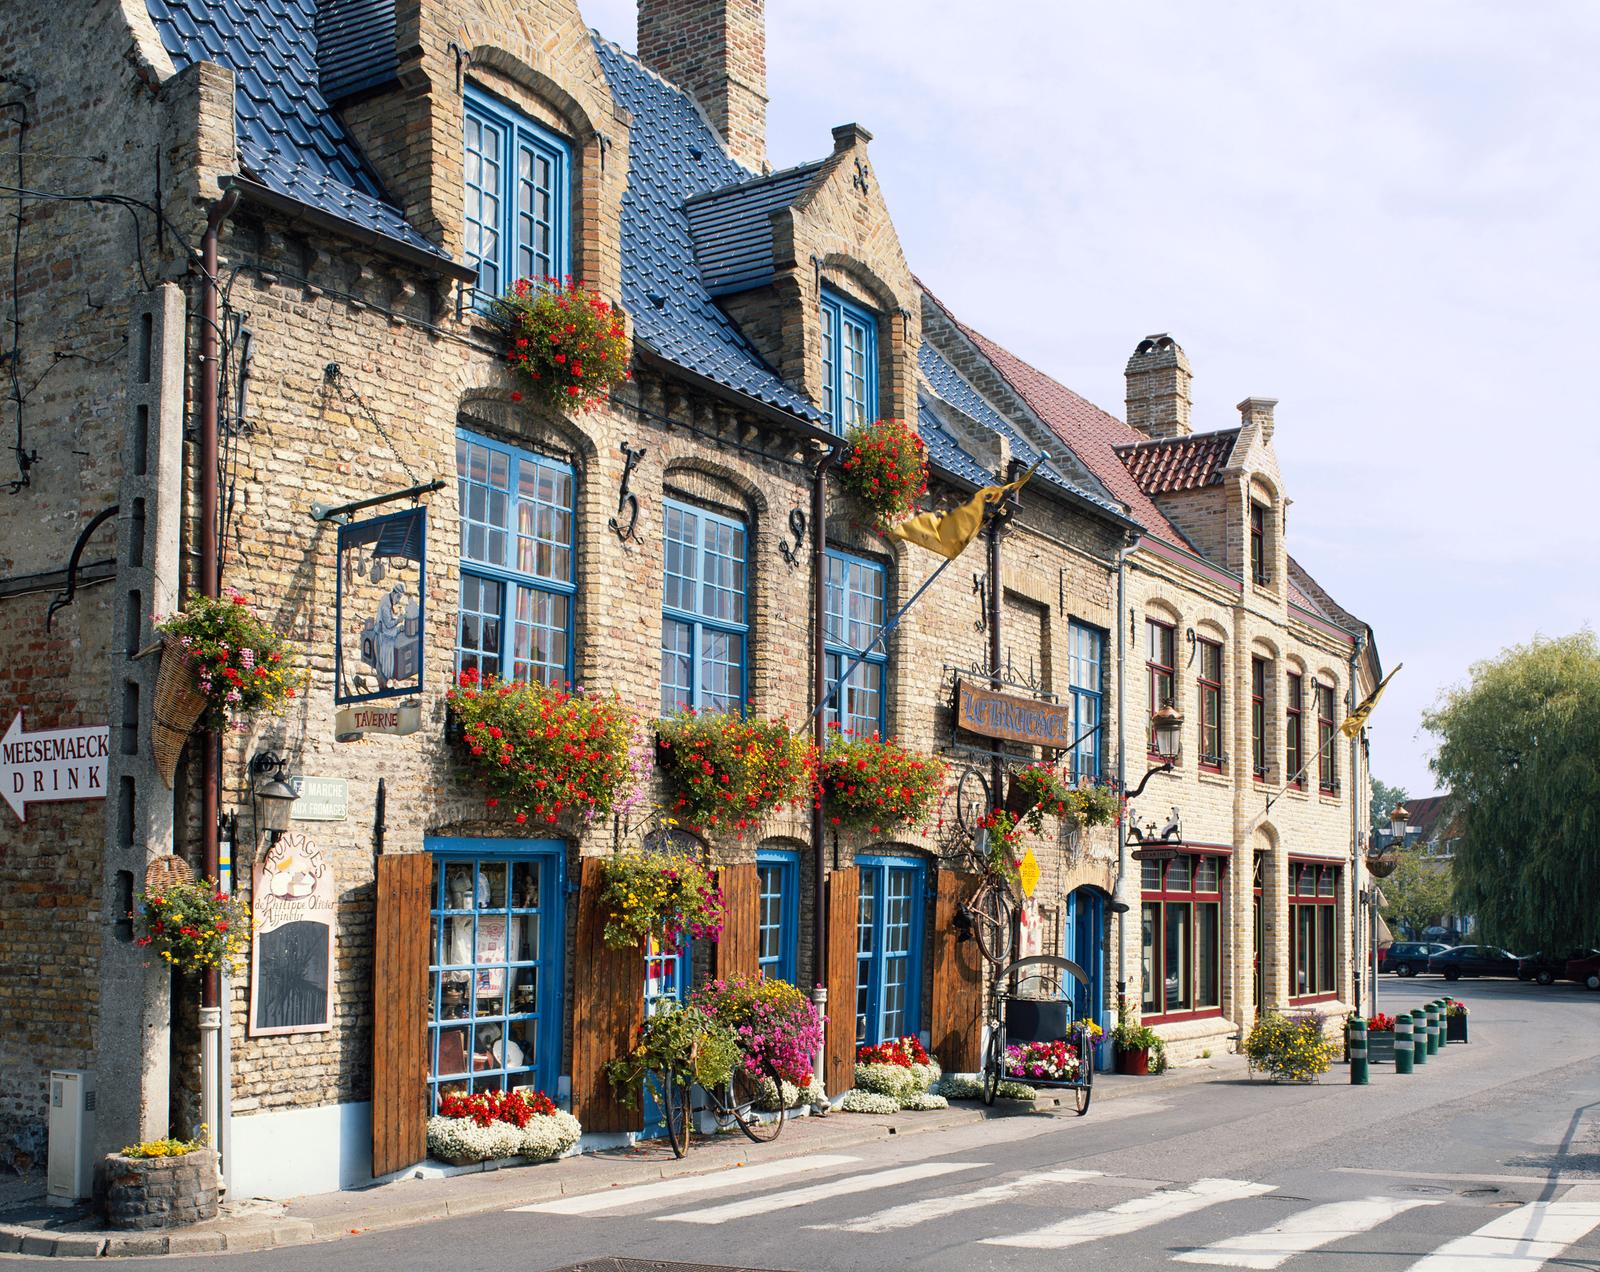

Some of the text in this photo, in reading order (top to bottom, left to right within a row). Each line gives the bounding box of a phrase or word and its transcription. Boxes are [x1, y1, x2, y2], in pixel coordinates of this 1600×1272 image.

[354, 711, 398, 728] TAVERNE
[3, 734, 109, 764] MEESEMAECK
[13, 766, 101, 793] DRINK
[308, 783, 343, 797] MARCHE
[293, 802, 346, 816] AUX FROMAGES
[262, 833, 326, 878] FROMAGES
[254, 898, 264, 910] de
[263, 893, 306, 912] Philippe
